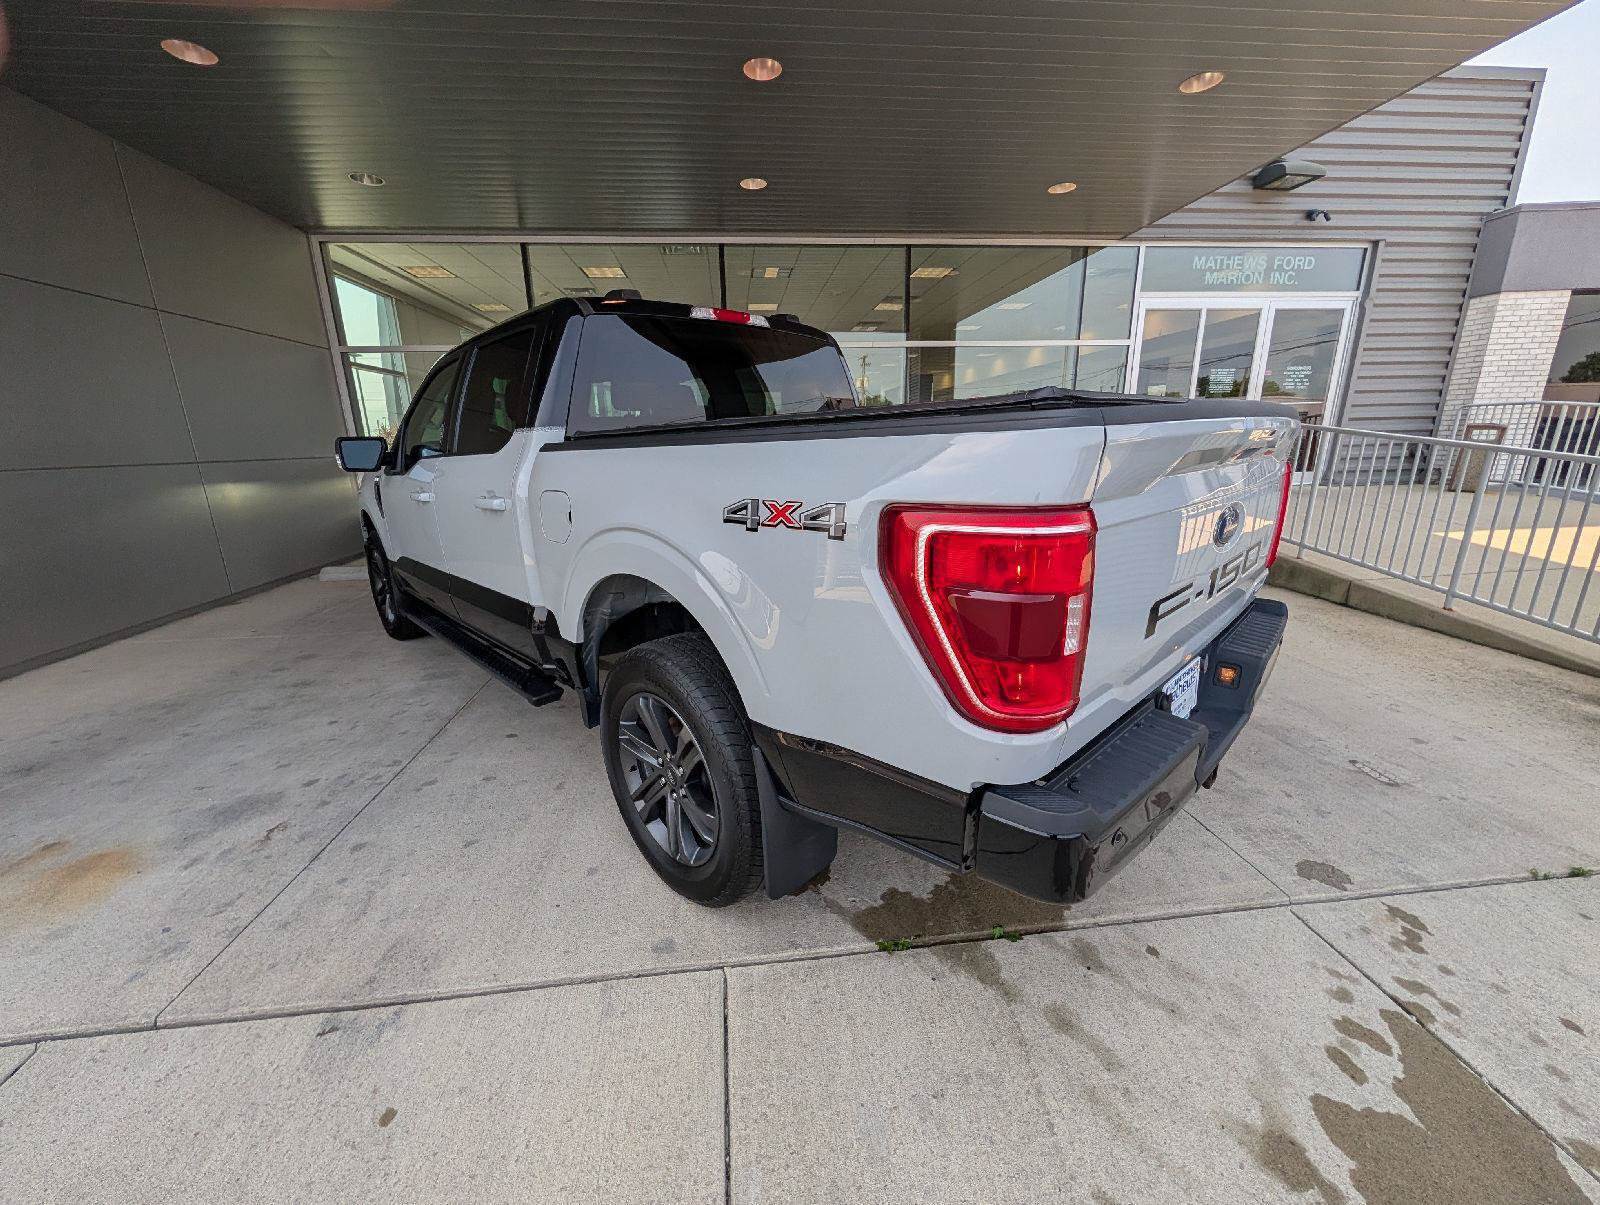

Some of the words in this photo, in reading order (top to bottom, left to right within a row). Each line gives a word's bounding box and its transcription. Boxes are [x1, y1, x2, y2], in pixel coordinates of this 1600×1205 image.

[1192, 255, 1268, 270] MATHEWS
[1273, 255, 1316, 270] FORD
[1204, 271, 1265, 285] MARION
[1269, 271, 1299, 285] INC.
[1144, 540, 1262, 640] F-150
